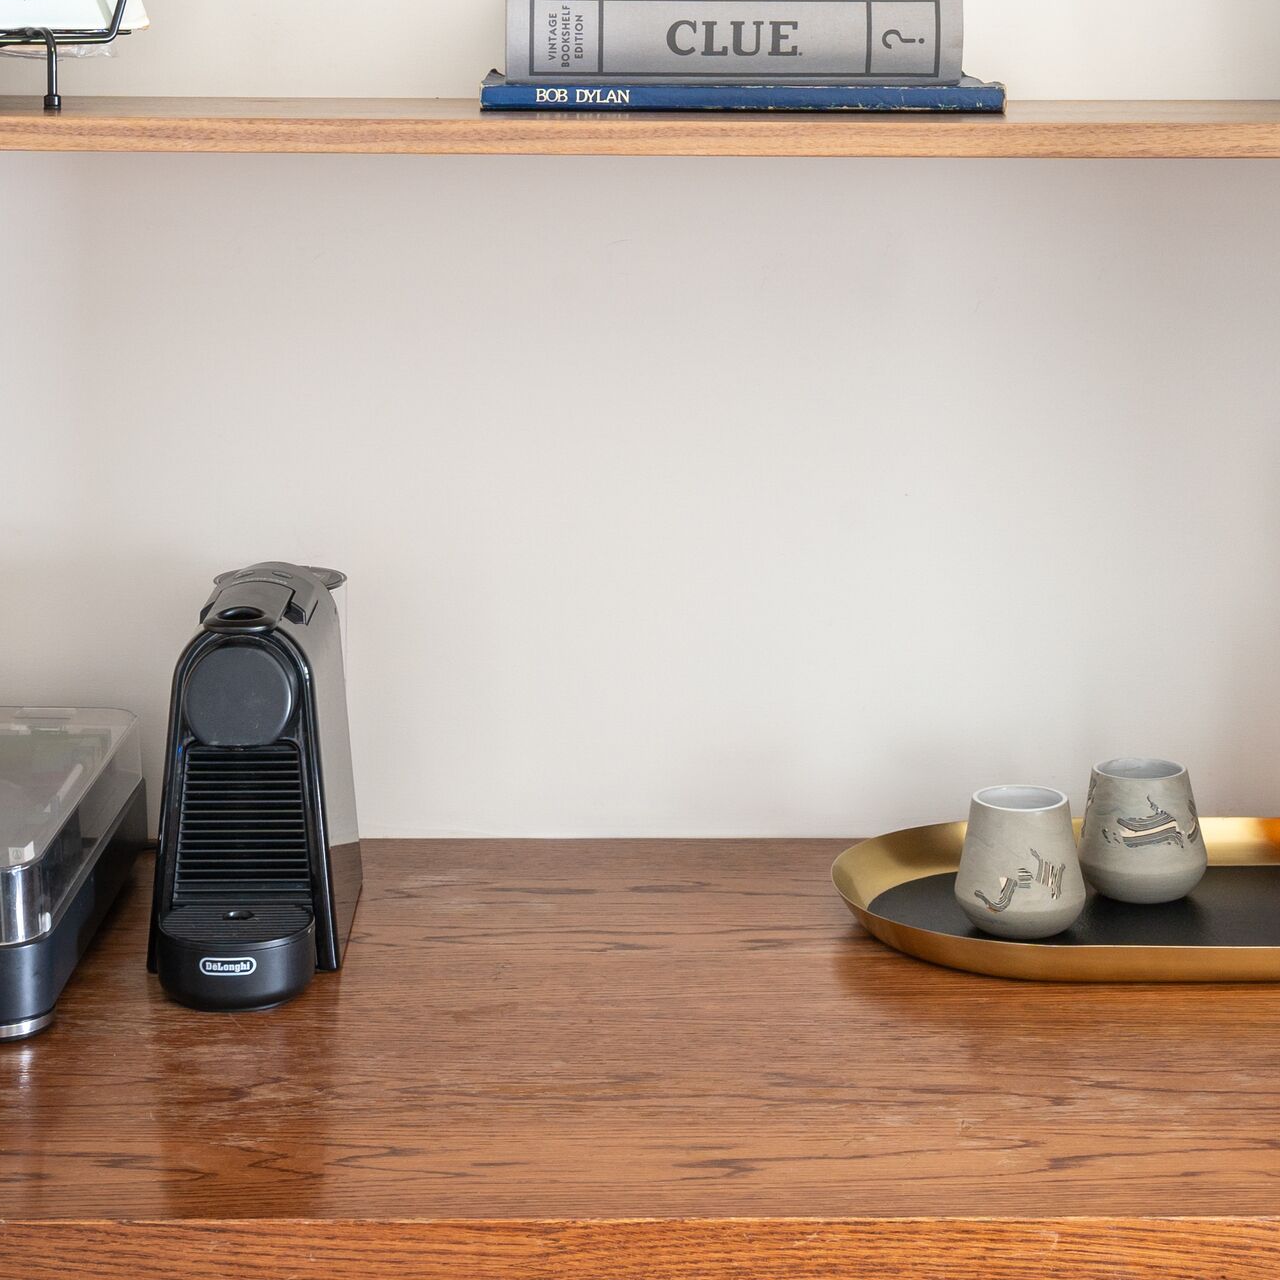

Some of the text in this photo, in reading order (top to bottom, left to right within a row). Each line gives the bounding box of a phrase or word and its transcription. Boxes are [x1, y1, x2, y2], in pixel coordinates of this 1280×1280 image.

[548, 12, 558, 61] VINTAGE
[561, 5, 571, 68] BOOKSHELF
[574, 14, 584, 59] EDITION
[535, 88, 631, 103] BOB DYLAN
